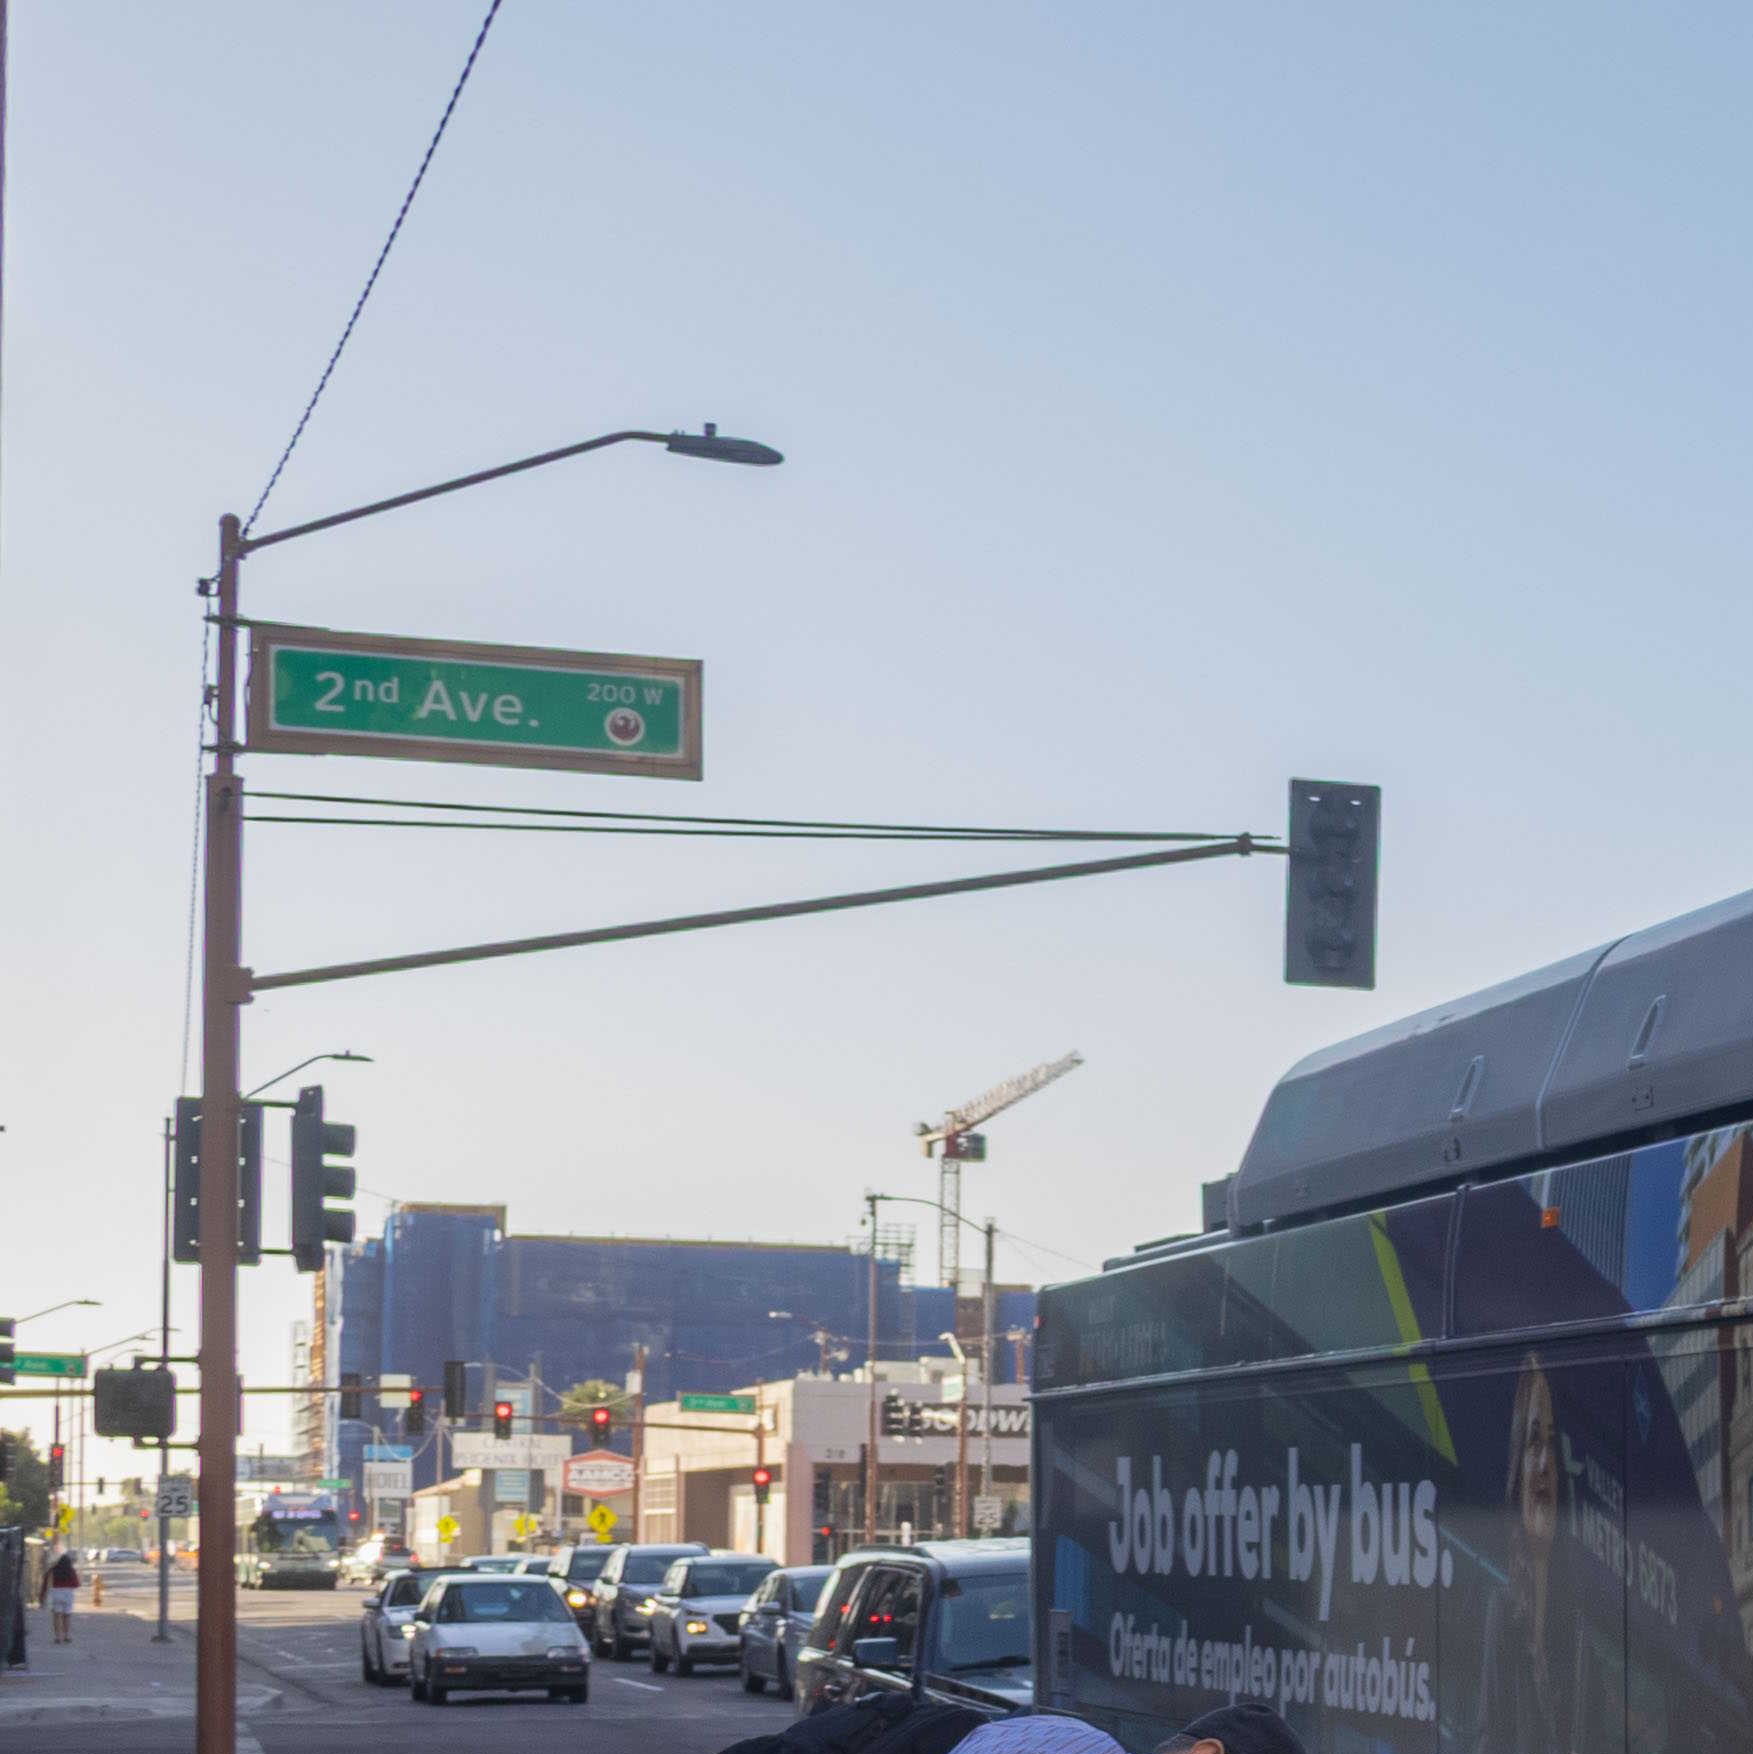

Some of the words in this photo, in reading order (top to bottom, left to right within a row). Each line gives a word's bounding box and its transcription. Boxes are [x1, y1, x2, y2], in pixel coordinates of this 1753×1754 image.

[314, 671, 399, 713] 2nd
[417, 679, 539, 728] Ave.
[586, 683, 636, 704] 200
[643, 687, 664, 706] W
[159, 1495, 189, 1514] 25
[1108, 1454, 1175, 1575] Job
[1183, 1449, 1281, 1580] offer
[1288, 1446, 1342, 1621] by
[1351, 1442, 1454, 1589] bus.
[1109, 1611, 1171, 1684] Oferta
[1174, 1619, 1199, 1687] de
[1201, 1624, 1277, 1705] empleo
[1280, 1647, 1322, 1719] por
[1323, 1637, 1437, 1722] autobús.
